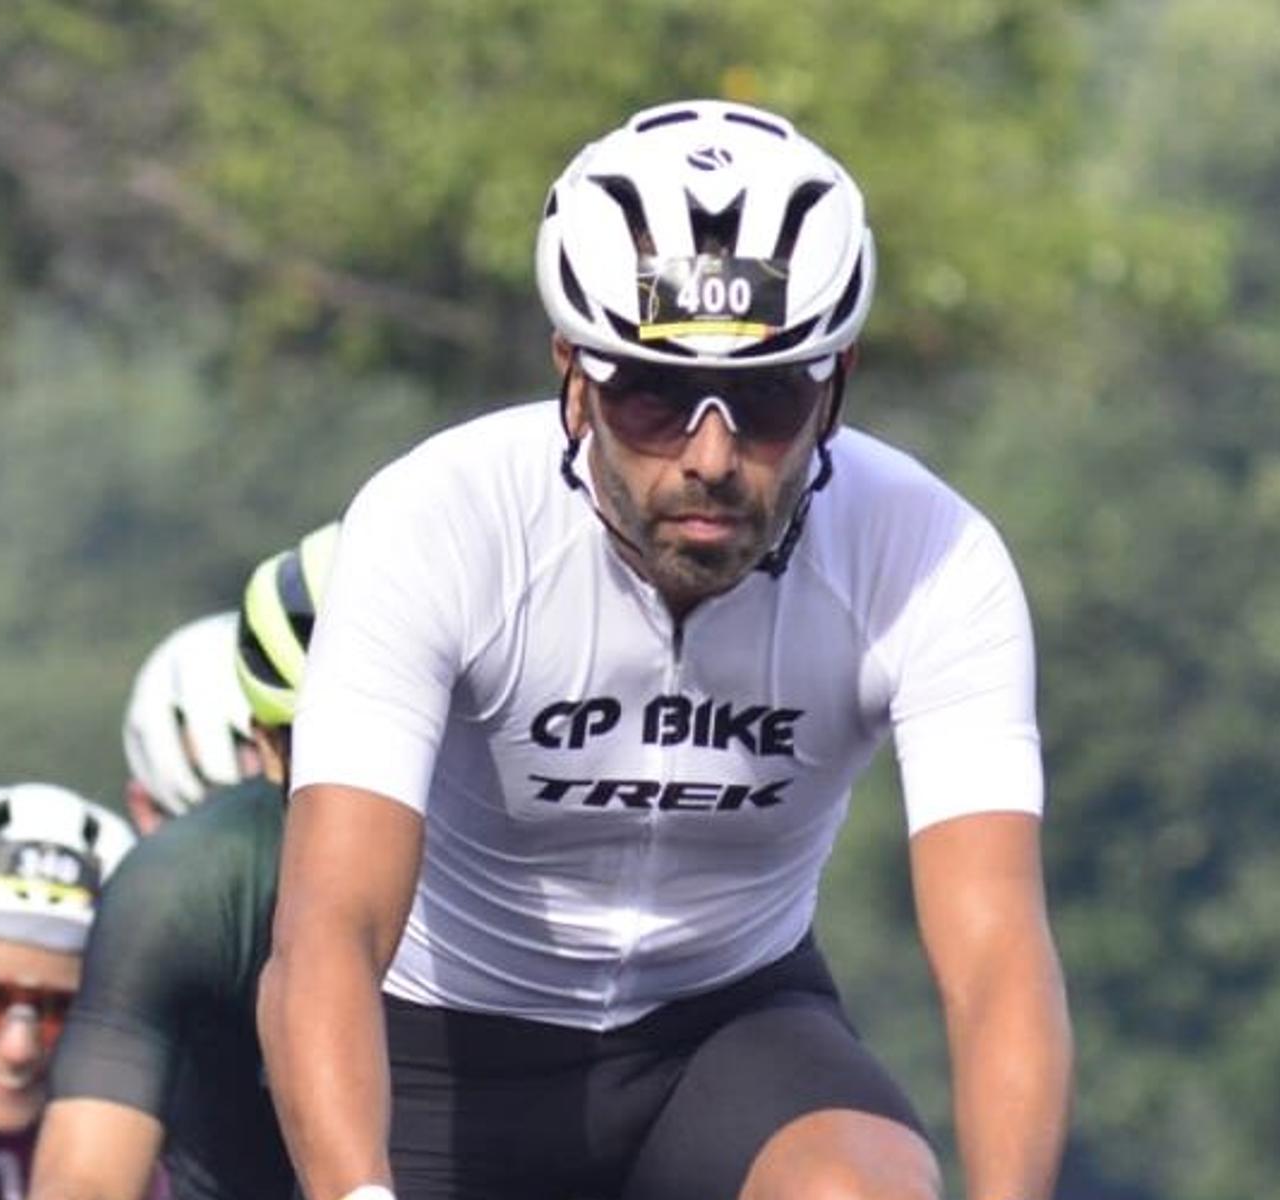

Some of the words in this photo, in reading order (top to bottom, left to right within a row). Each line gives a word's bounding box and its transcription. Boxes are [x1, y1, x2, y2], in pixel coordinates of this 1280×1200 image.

[675, 277, 752, 314] 400
[530, 696, 622, 750] CP
[641, 694, 806, 757] BIKE
[527, 773, 794, 812] TREK
